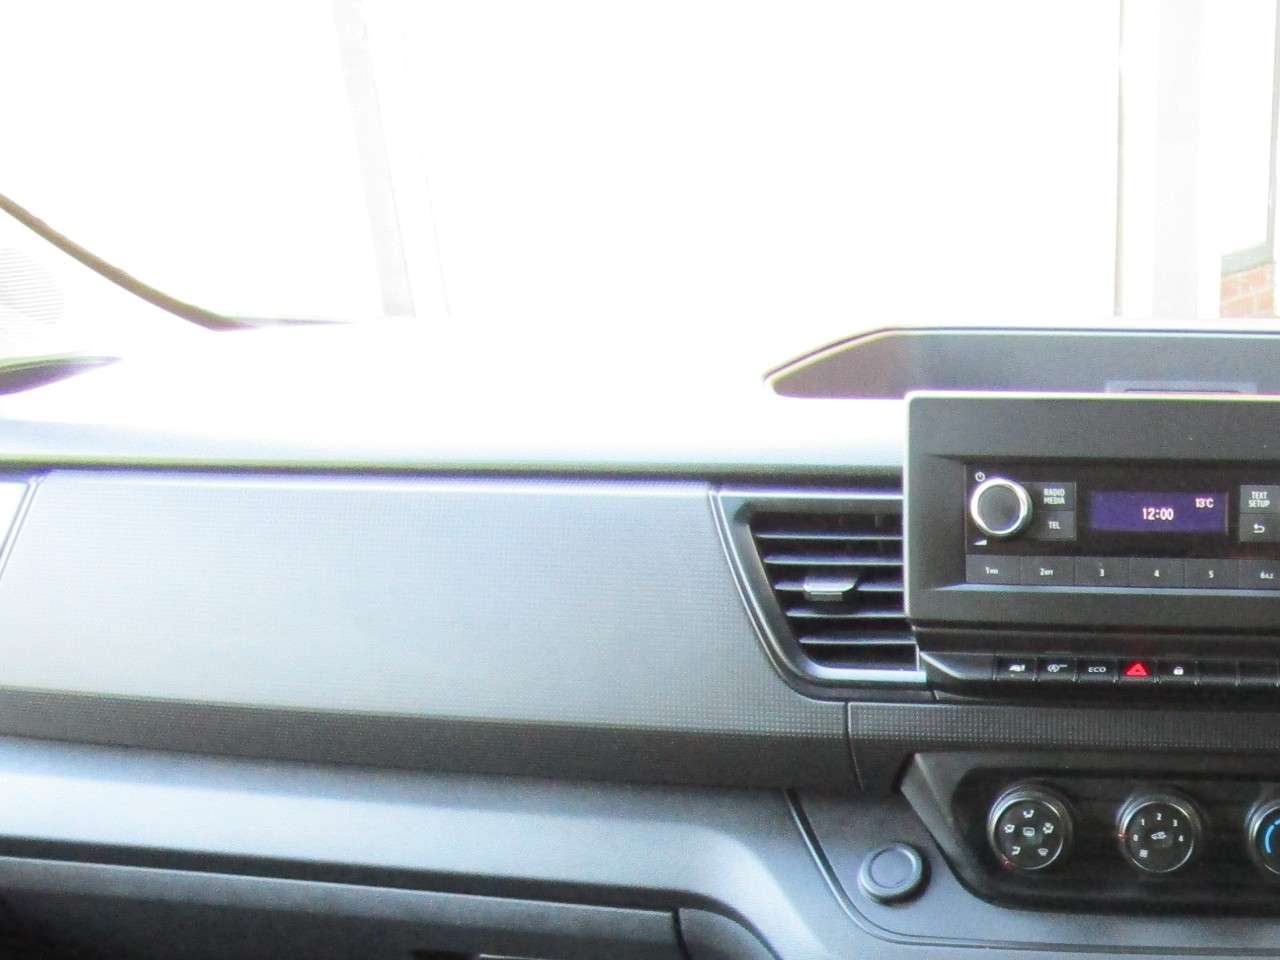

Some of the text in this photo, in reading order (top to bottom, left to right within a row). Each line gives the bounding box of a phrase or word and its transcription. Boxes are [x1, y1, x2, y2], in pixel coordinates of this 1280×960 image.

[1043, 488, 1065, 496] RADIO
[1251, 492, 1267, 500] TEXT
[1043, 496, 1065, 504] MEDIA
[1248, 500, 1270, 508] SETUP
[1142, 508, 1174, 520] 12:00
[1048, 520, 1061, 529] TEL
[1153, 569, 1160, 577] 4
